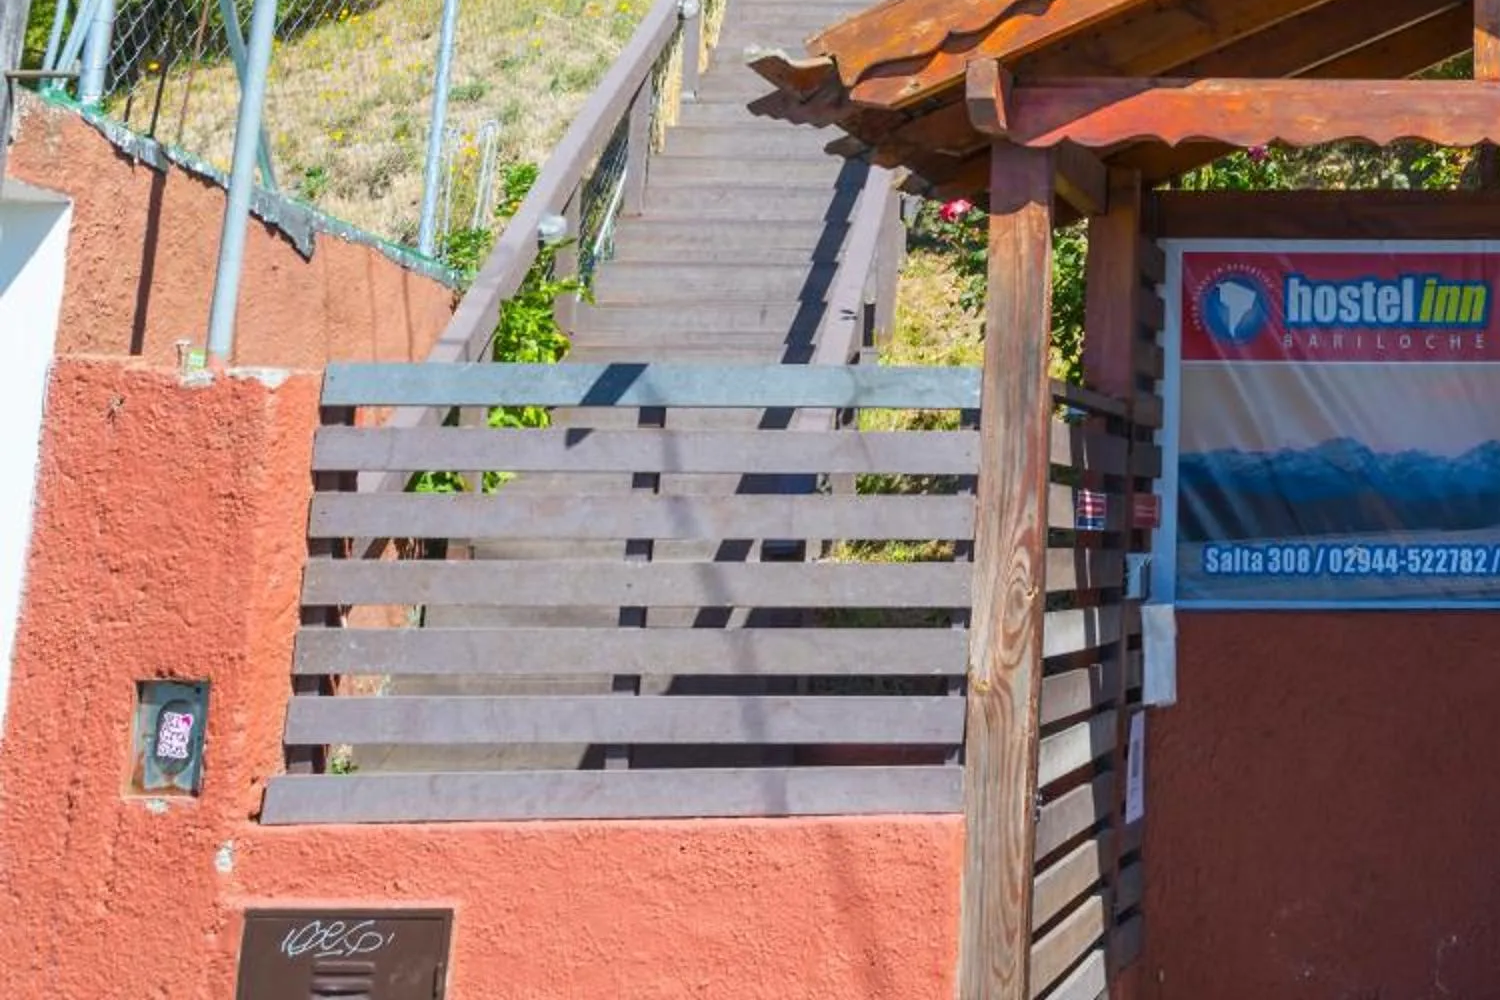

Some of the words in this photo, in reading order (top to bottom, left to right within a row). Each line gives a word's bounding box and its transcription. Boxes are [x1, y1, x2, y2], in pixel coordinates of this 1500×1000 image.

[1287, 276, 1415, 324] hostel
[1419, 278, 1487, 323] inn
[1283, 334, 1485, 349] BARILOCHE
[1205, 548, 1264, 573] Salta
[1267, 547, 1311, 574] 308
